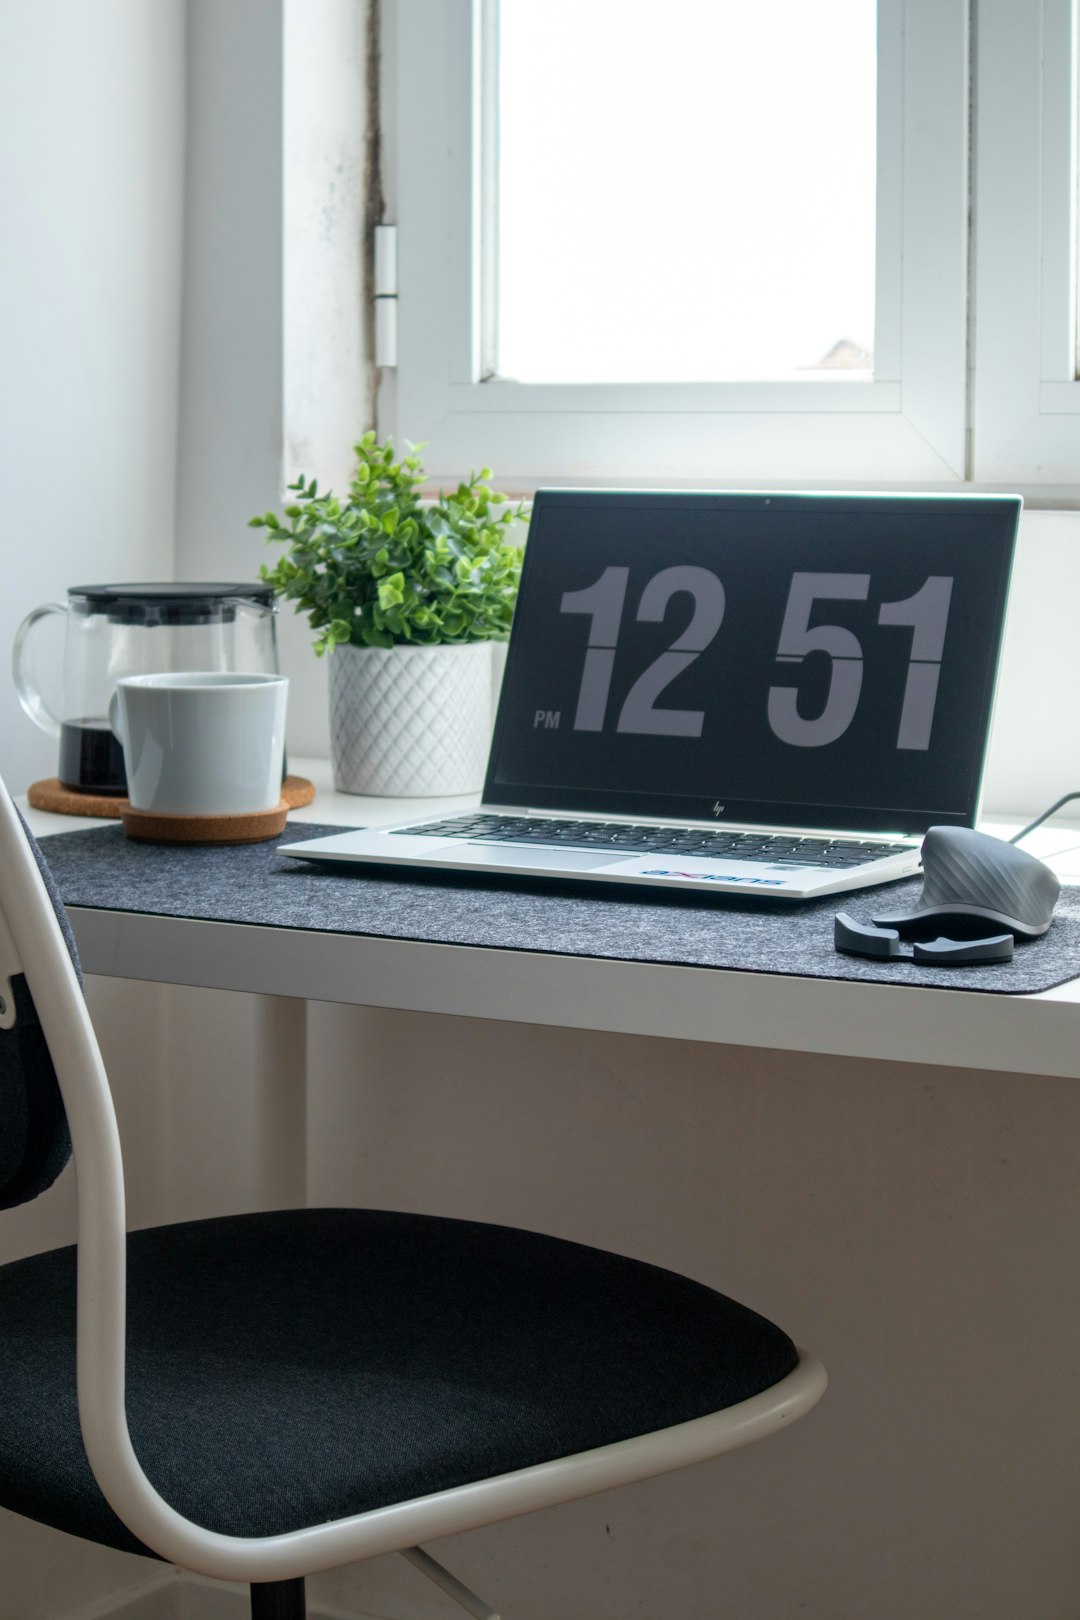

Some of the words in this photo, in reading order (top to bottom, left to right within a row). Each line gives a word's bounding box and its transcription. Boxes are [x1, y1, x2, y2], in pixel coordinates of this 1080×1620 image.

[560, 565, 726, 738] 12
[767, 571, 954, 751] 51
[533, 710, 560, 730] PM
[713, 800, 724, 817] hp
[641, 870, 786, 885] axians
